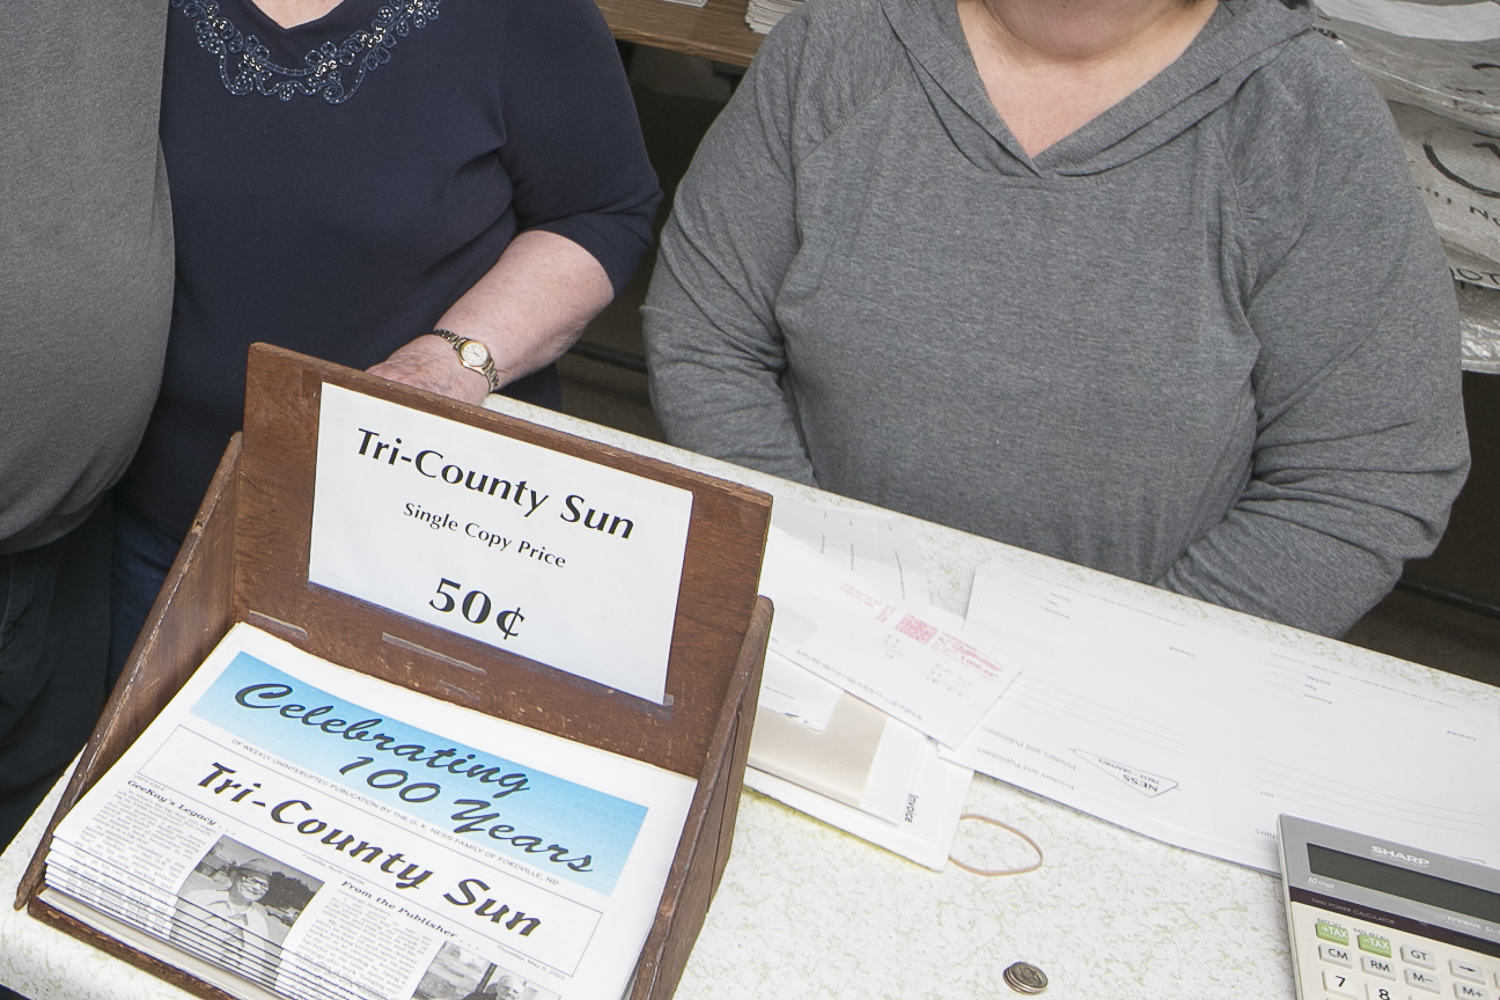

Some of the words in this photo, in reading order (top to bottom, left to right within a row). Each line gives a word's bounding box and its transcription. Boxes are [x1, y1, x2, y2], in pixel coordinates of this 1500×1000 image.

[356, 427, 549, 518] Tri-County
[560, 494, 634, 540] Sun
[403, 502, 459, 532] Single
[464, 522, 512, 552] Copy
[517, 540, 567, 568] Price
[428, 577, 525, 641] 50¢
[235, 683, 529, 798] Celebrating
[980, 724, 1024, 750] Publishers
[1025, 743, 1042, 757] and
[1043, 750, 1076, 771] Printers
[1023, 763, 1039, 776] and
[1041, 772, 1074, 791] Printers
[1122, 773, 1158, 793] NESS
[127, 779, 176, 806] GeeKay's
[177, 804, 217, 826] Legacy
[240, 744, 272, 761] WEEKLY
[328, 783, 380, 809] PUBLICATION
[379, 805, 392, 814] BY
[392, 811, 408, 821] THE
[453, 837, 483, 854] FAMILY
[483, 850, 497, 860] OF
[496, 855, 544, 880] FORDVILLE,
[904, 793, 919, 823] Invoice
[339, 756, 440, 802] 100
[450, 799, 591, 871] Years
[198, 762, 432, 888] Tri-County
[443, 879, 540, 935] Sun
[1371, 845, 1430, 865] SHARP
[339, 879, 373, 899] From
[374, 896, 396, 910] the
[397, 906, 458, 939] Publisher
[1329, 902, 1351, 913] POWER
[1353, 908, 1395, 925] CALCULATOR
[1321, 926, 1348, 940] +TAX
[1328, 949, 1348, 961] CM
[1410, 950, 1428, 961] GT
[1370, 960, 1390, 972] RM
[1335, 975, 1346, 988] 7
[1462, 986, 1483, 998] M+
[1378, 989, 1391, 1000] 8
